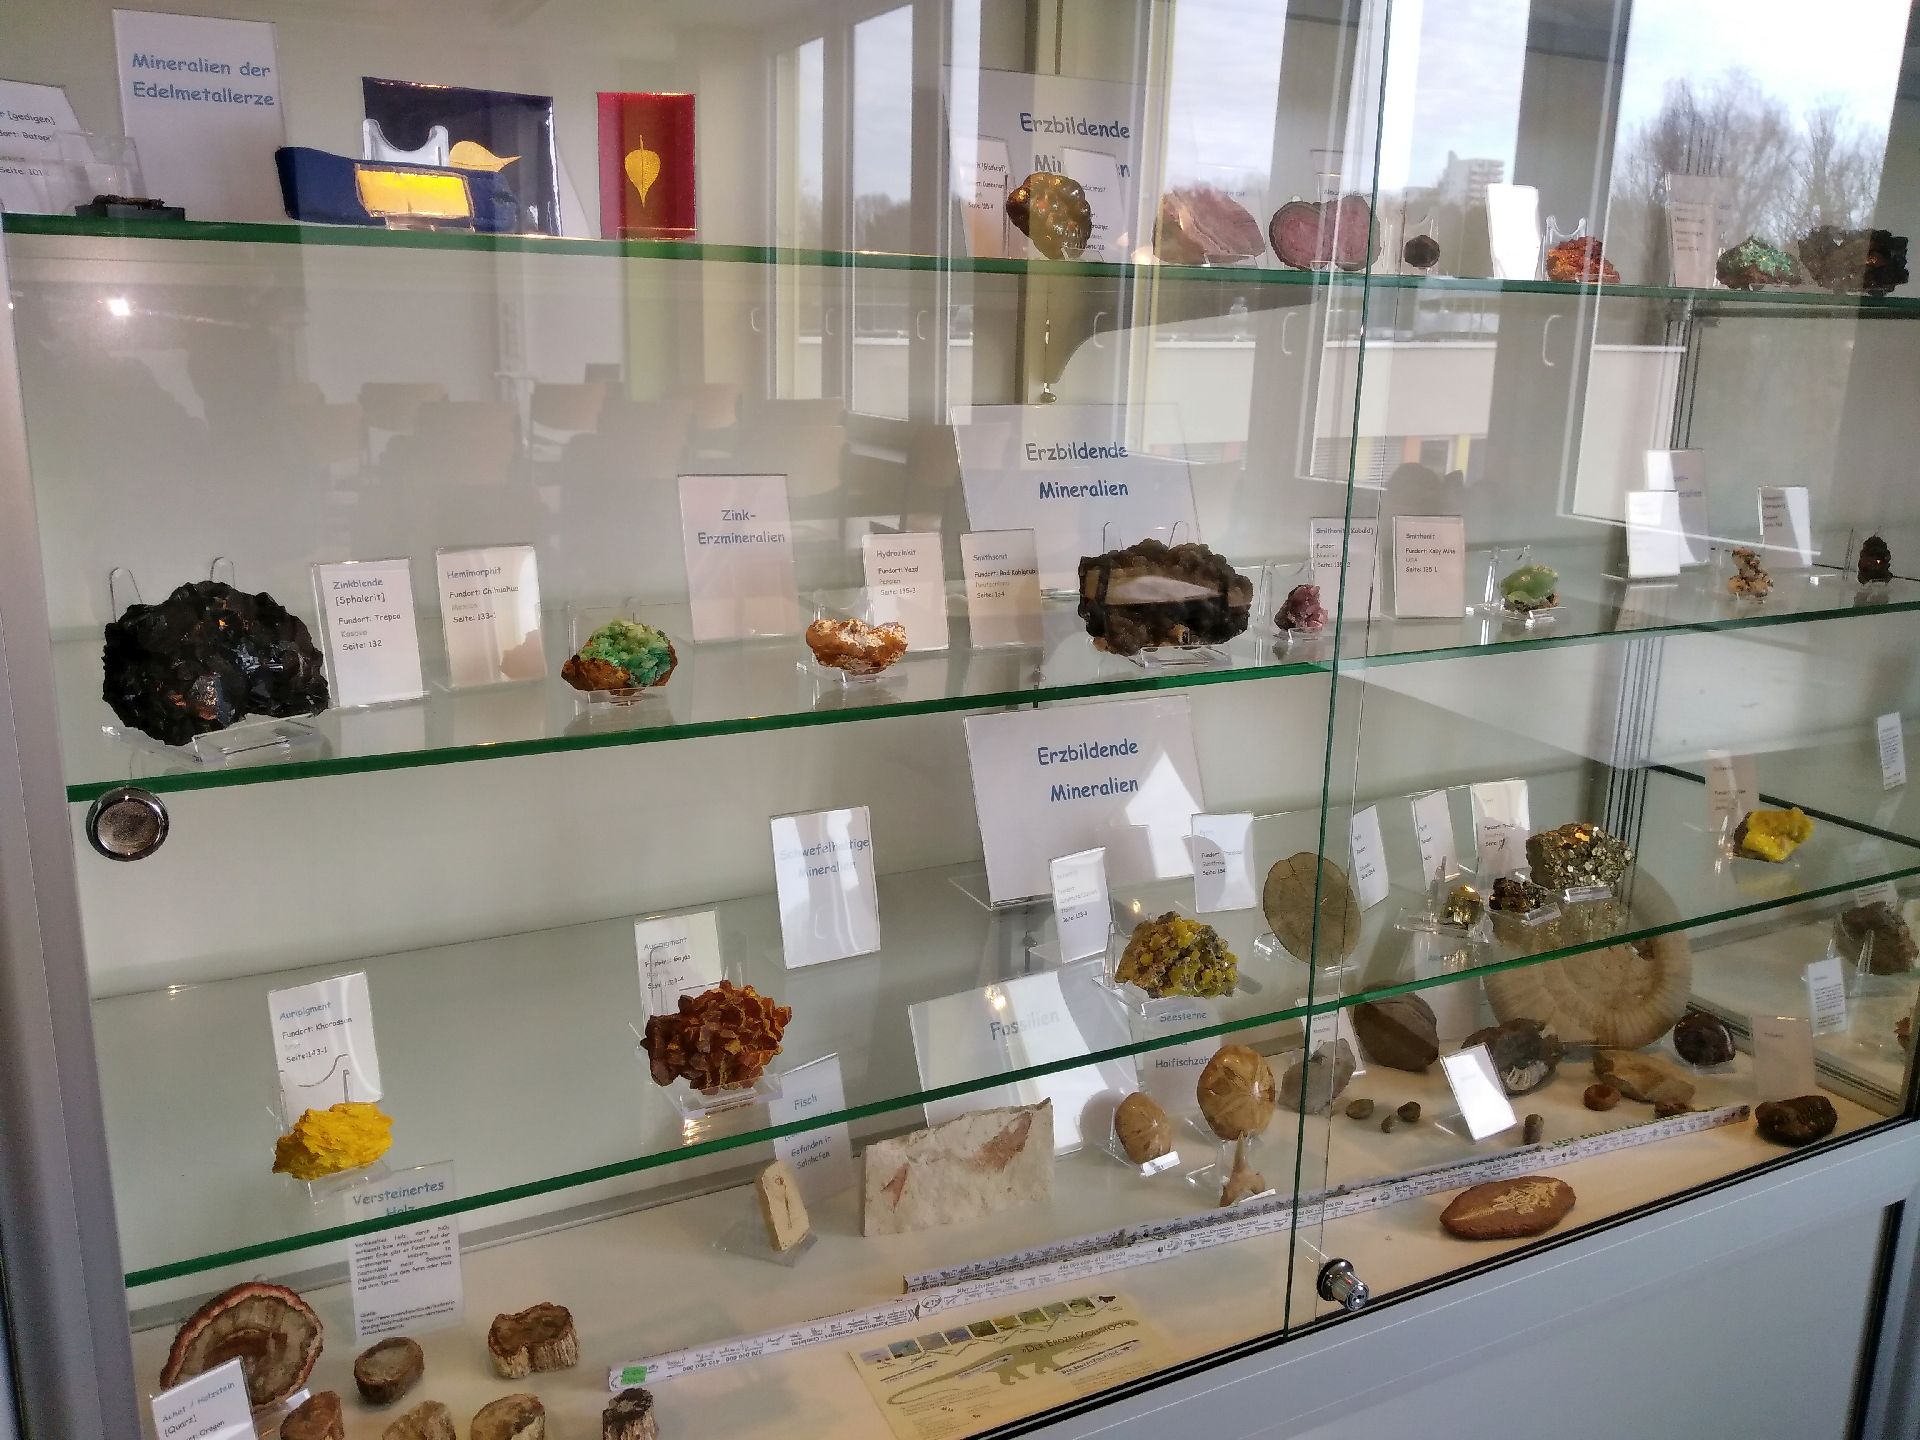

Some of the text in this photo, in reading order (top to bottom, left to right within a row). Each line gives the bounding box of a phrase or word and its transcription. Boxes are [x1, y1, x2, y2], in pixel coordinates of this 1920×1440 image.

[132, 53, 271, 77] Mineralien der
[133, 81, 275, 106] Edelmetallerze
[1020, 113, 1131, 138] Erzbildende
[1026, 442, 1128, 461] Erzbildende
[1039, 480, 1128, 499] Mineralien
[721, 510, 756, 521] Zink-
[697, 532, 785, 545] Erzmineralien
[447, 567, 501, 579] Hemimorphit
[333, 578, 383, 589] Zinkblende
[343, 640, 382, 650] Seite: 132
[1038, 738, 1139, 766] Erzbildende
[1051, 777, 1139, 802] Mineralien
[280, 1002, 331, 1020] Auripigment
[1160, 1011, 1207, 1022] Seesterne
[283, 1026, 314, 1039] Fundort:
[1155, 1056, 1211, 1069] Haifischzah
[794, 1093, 818, 1111] Fisch
[791, 1140, 823, 1157] Gefunden
[353, 1181, 445, 1206] Versteinertes
